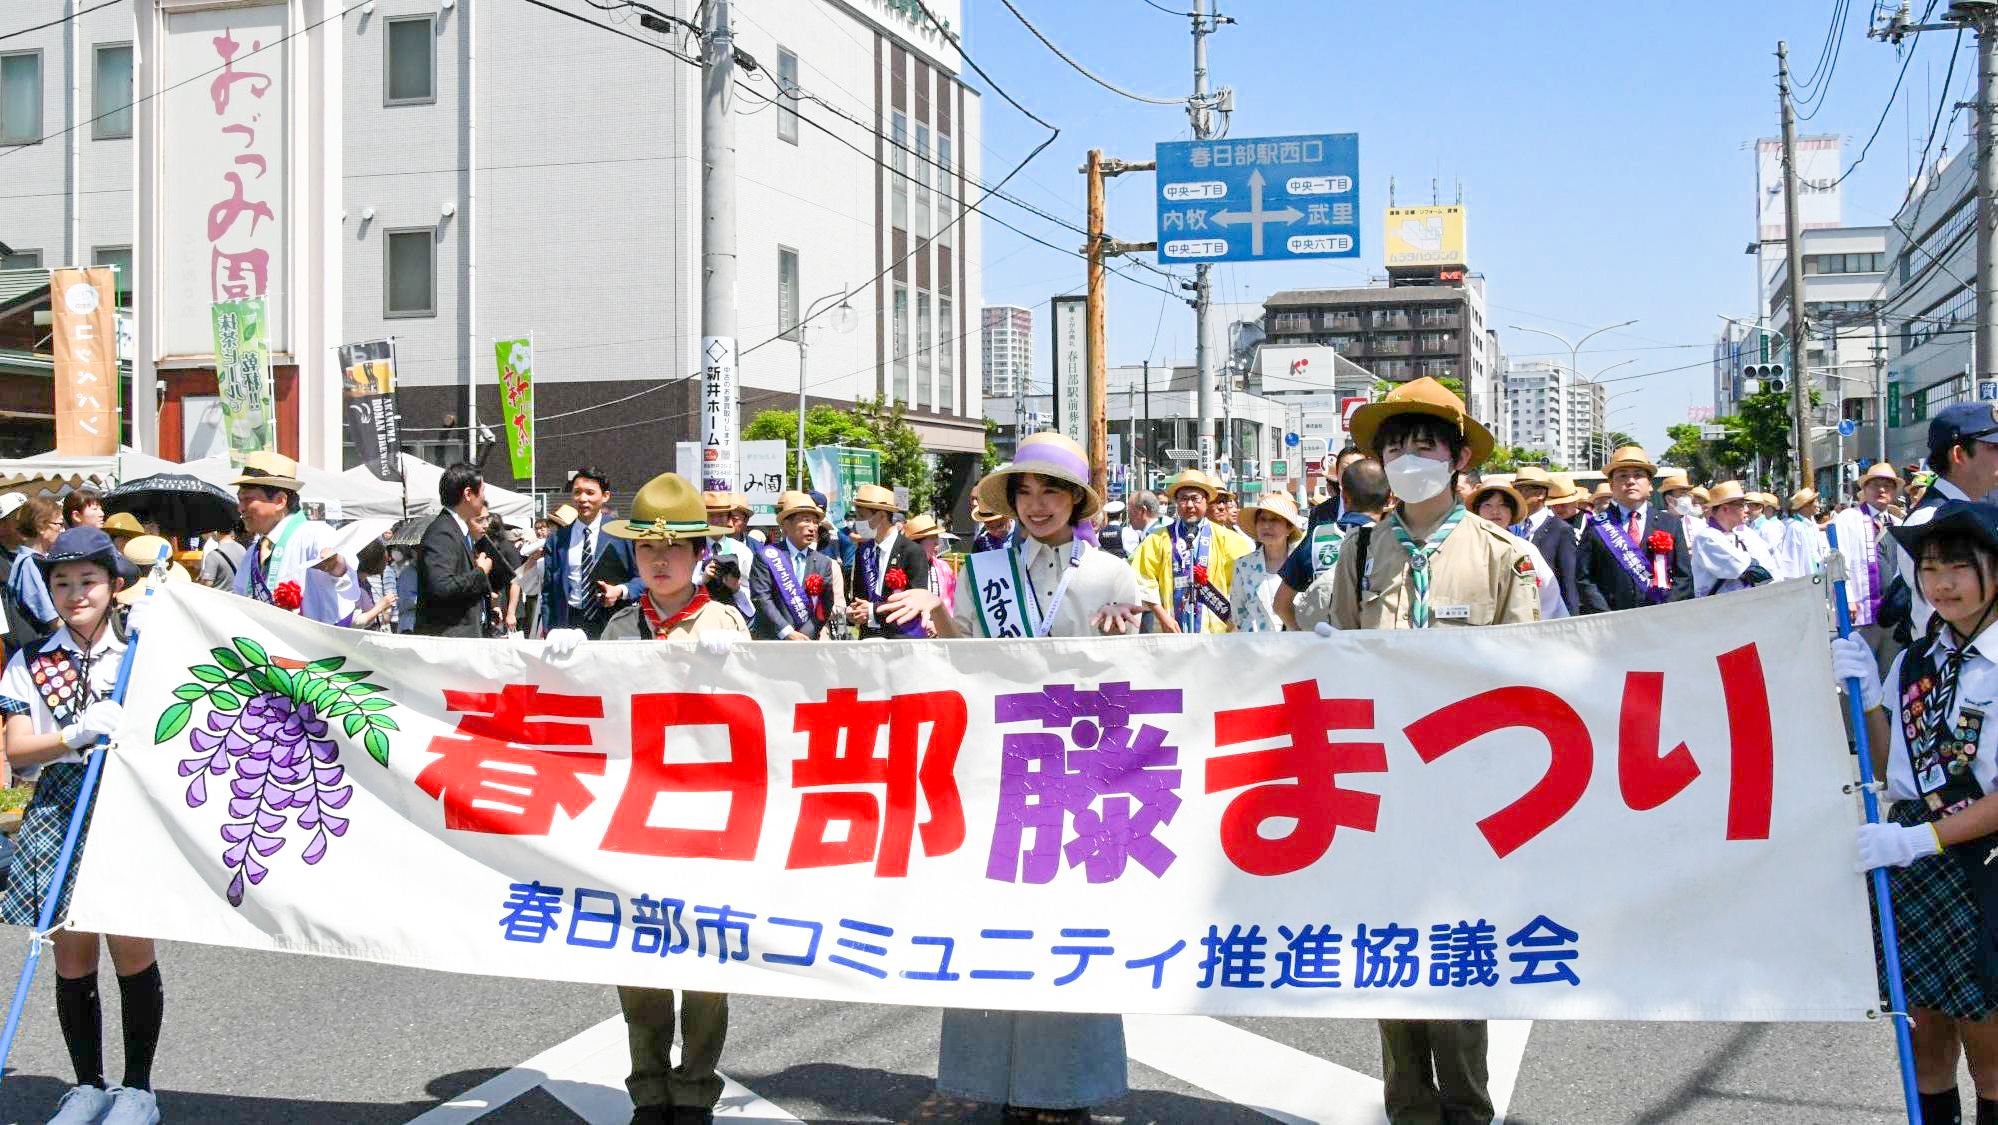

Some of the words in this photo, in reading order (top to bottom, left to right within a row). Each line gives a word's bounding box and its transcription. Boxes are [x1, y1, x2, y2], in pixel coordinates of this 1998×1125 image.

[207, 26, 274, 303] おづつみ園
[1189, 141, 1323, 167] 春日部駅西口
[1168, 184, 1223, 196] 中央一丁目
[1291, 178, 1347, 191] 中央一丁目
[1163, 209, 1208, 231] 内牧
[1307, 202, 1353, 225] 武里
[1168, 242, 1224, 254] 中央二丁目
[1291, 237, 1348, 250] 中央六丁目
[707, 366, 721, 446] 新井ホーム
[414, 642, 1774, 884] 春日部藤まつり
[498, 880, 1581, 990] 春日部市コミュニティ推進協議会
